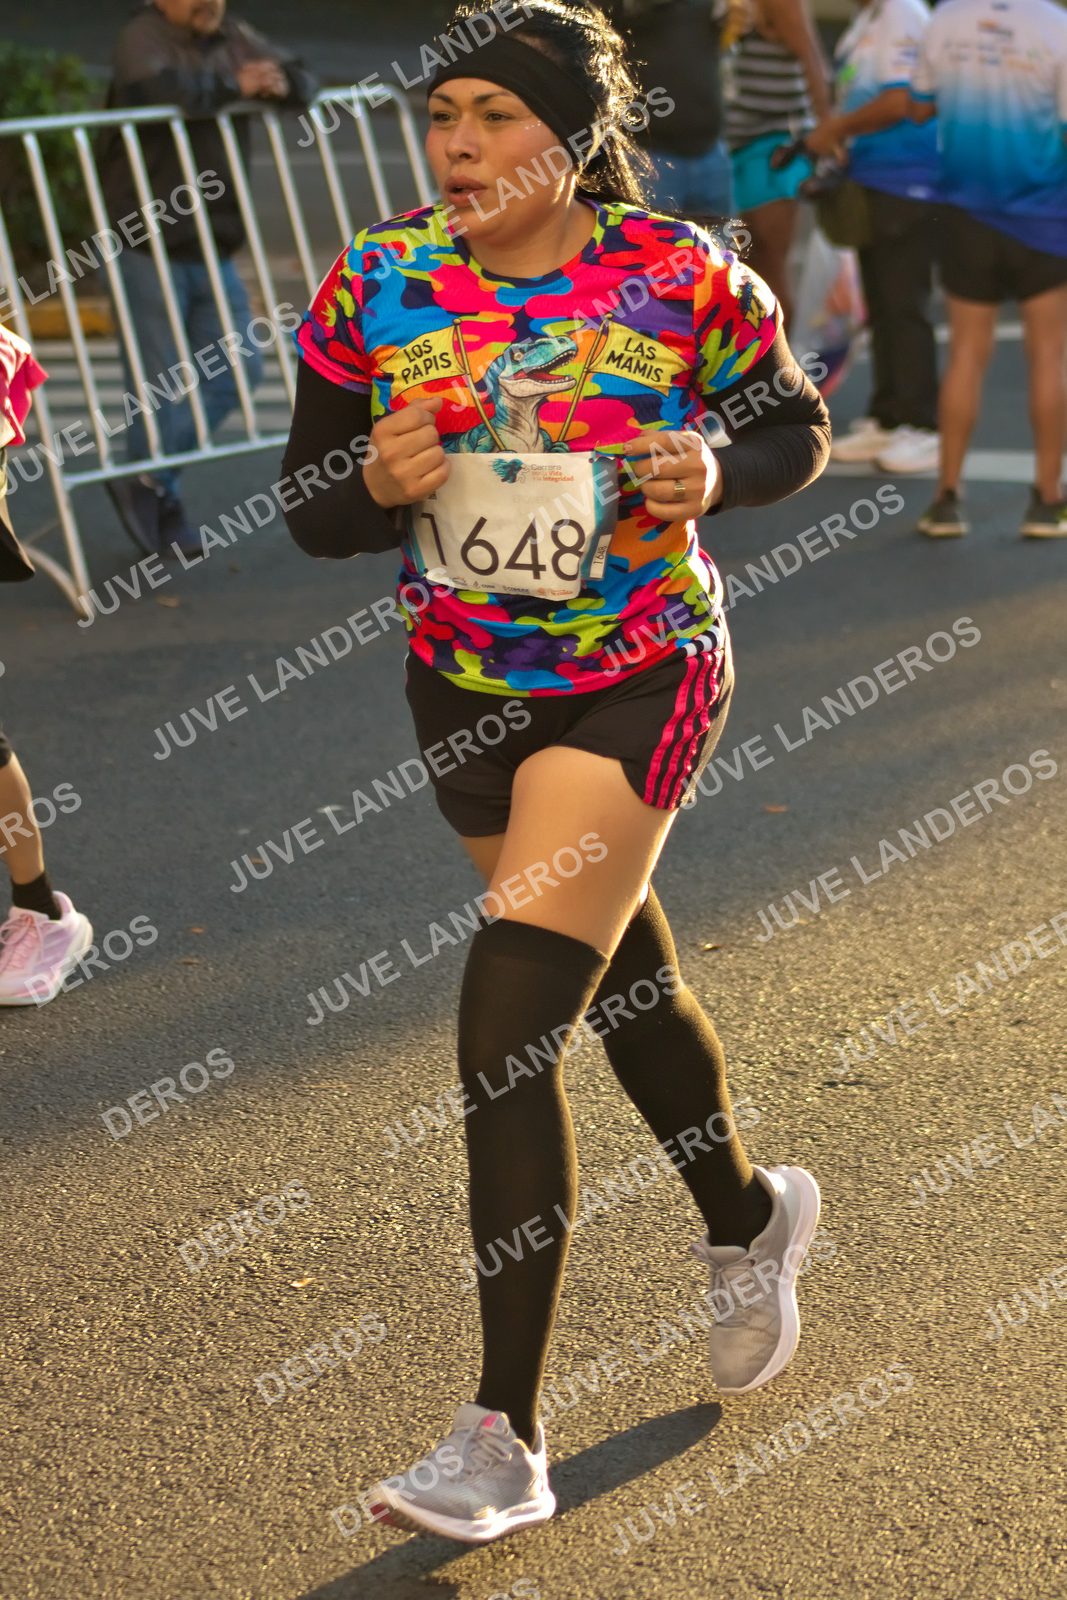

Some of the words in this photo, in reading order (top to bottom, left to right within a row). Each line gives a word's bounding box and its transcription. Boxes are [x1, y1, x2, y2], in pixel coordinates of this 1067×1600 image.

[403, 339, 432, 363] LOS
[624, 337, 657, 360] LAS
[401, 352, 451, 384] PAPIS
[605, 350, 663, 382] MAMIS
[421, 512, 586, 581] 1648
